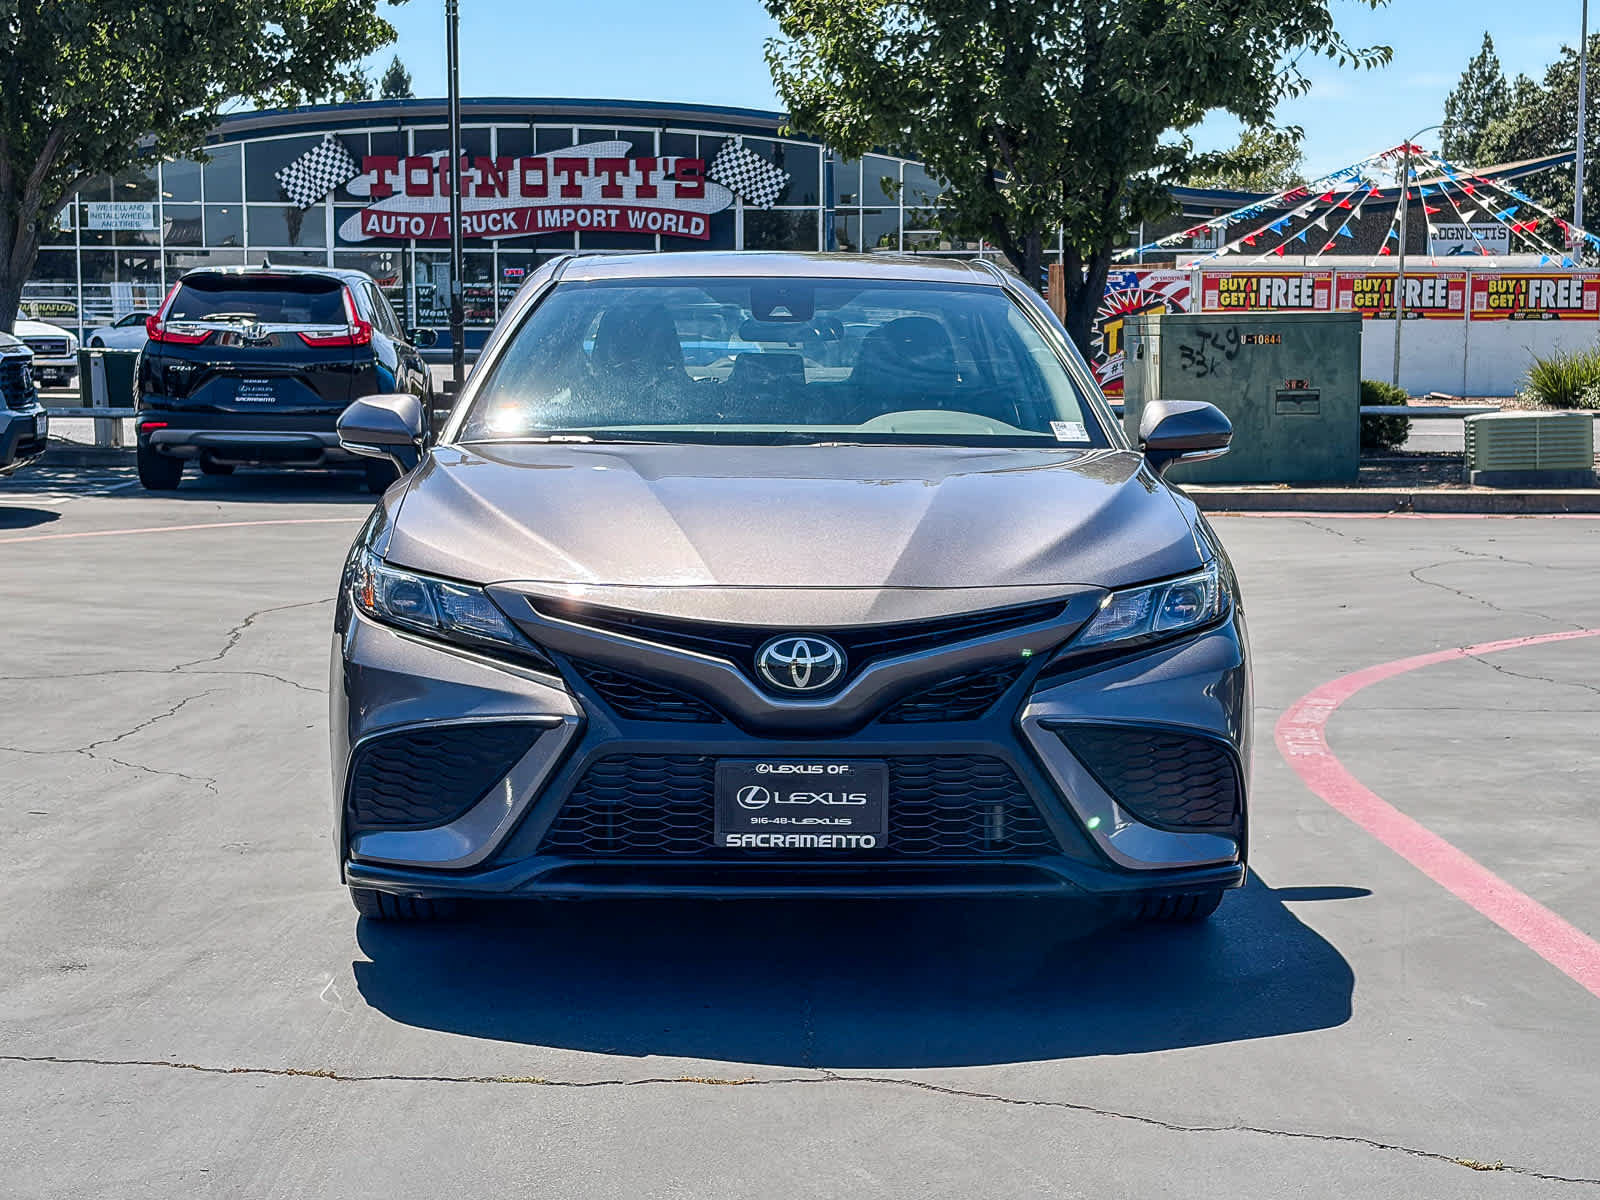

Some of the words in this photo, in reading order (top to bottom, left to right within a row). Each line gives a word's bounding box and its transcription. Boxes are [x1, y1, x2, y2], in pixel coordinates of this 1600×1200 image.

[362, 156, 705, 198] TOGNOTTI'S
[366, 214, 426, 236] AUTO
[537, 208, 620, 228] IMPORT
[628, 210, 705, 235] WORLD
[1219, 278, 1247, 291] BUY
[1252, 278, 1258, 291] 1
[1353, 279, 1381, 292] BUY
[1385, 279, 1392, 292] 1
[1488, 280, 1516, 293] BUY
[1520, 280, 1527, 293] 1
[1259, 278, 1313, 307] FREE
[1528, 280, 1583, 308] FREE
[1220, 293, 1245, 306] GET
[1250, 293, 1256, 305] 1
[1354, 293, 1380, 306] GET
[1384, 293, 1390, 306] 1
[1489, 294, 1515, 308] GET
[1519, 294, 1525, 307] 1
[769, 764, 824, 774] LEXUS
[826, 764, 849, 774] OF
[774, 791, 868, 806] LEXUS
[750, 816, 853, 826] 916-48-LEXUS
[725, 833, 877, 849] SACRAMENTO
